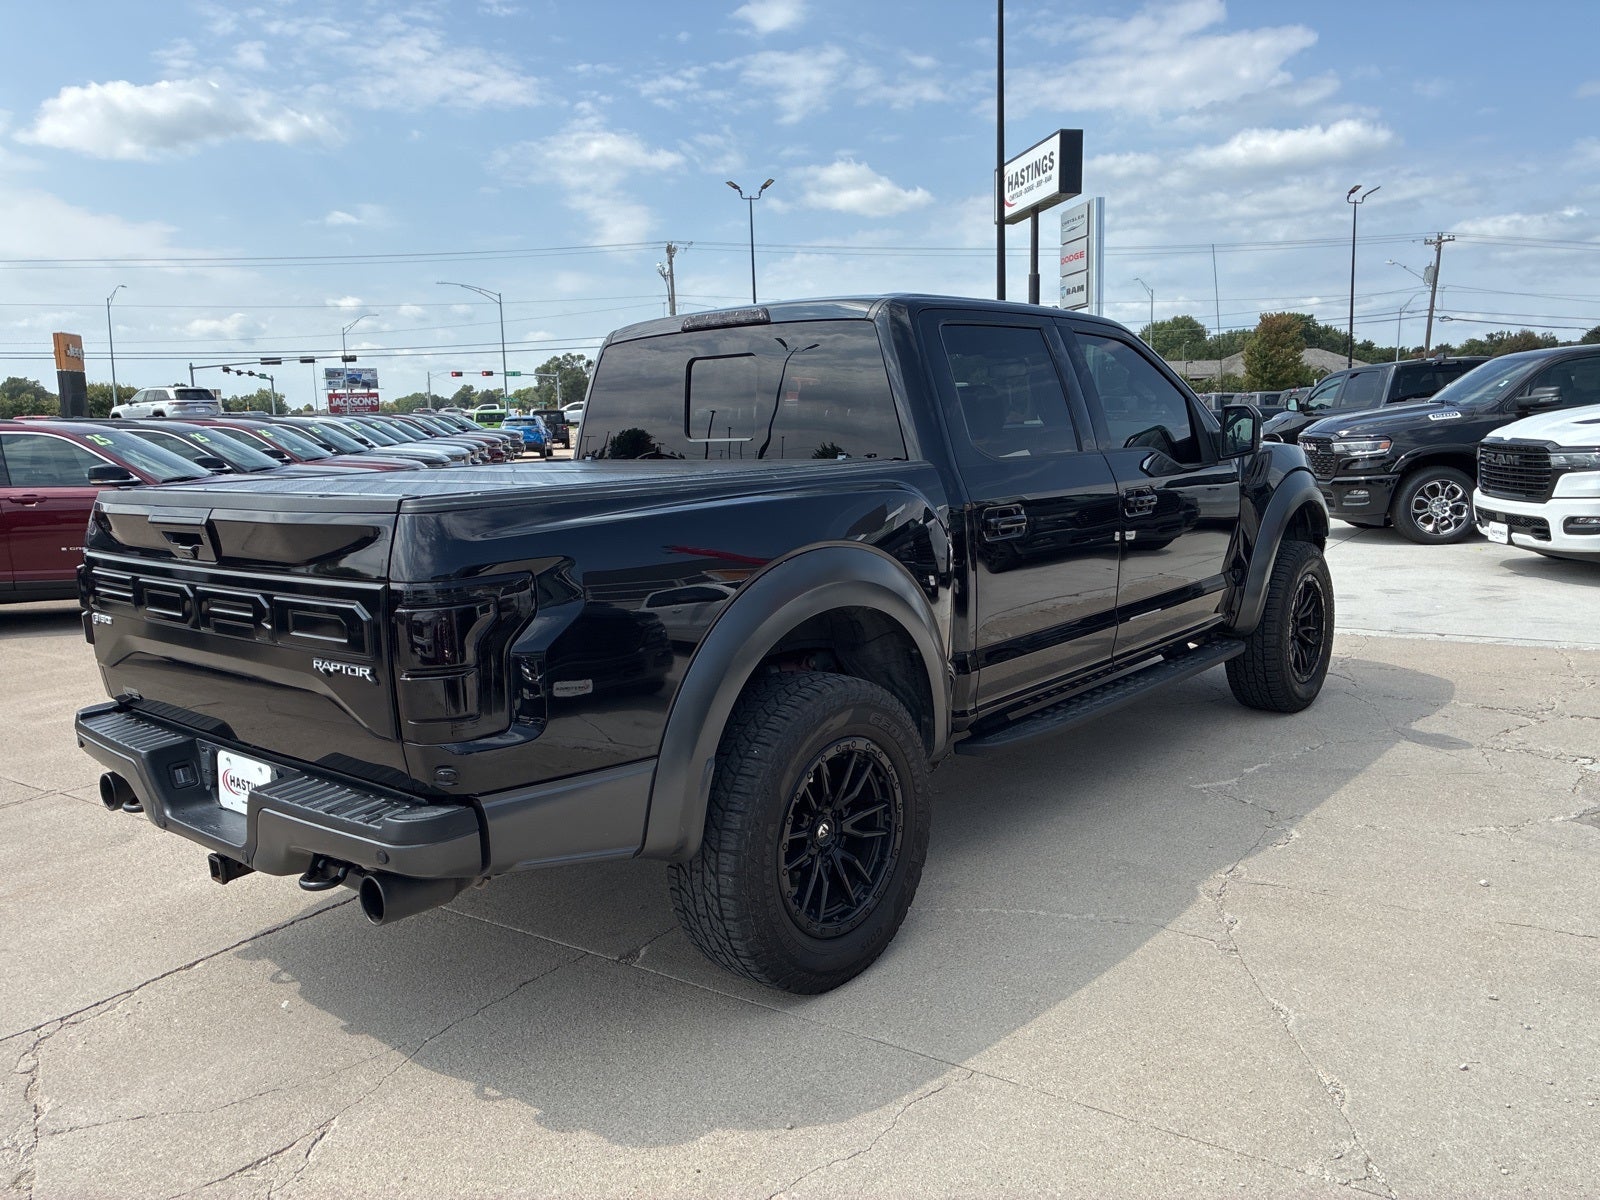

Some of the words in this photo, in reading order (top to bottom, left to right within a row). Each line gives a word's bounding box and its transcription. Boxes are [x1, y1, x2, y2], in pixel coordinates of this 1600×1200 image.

[1007, 151, 1055, 193] HASTINGS
[1061, 250, 1085, 265] DODGE
[1066, 284, 1085, 296] RAM
[86, 434, 114, 446] 25
[1485, 452, 1520, 466] RAM
[91, 567, 374, 658] FORD
[312, 657, 372, 682] RAPTOR
